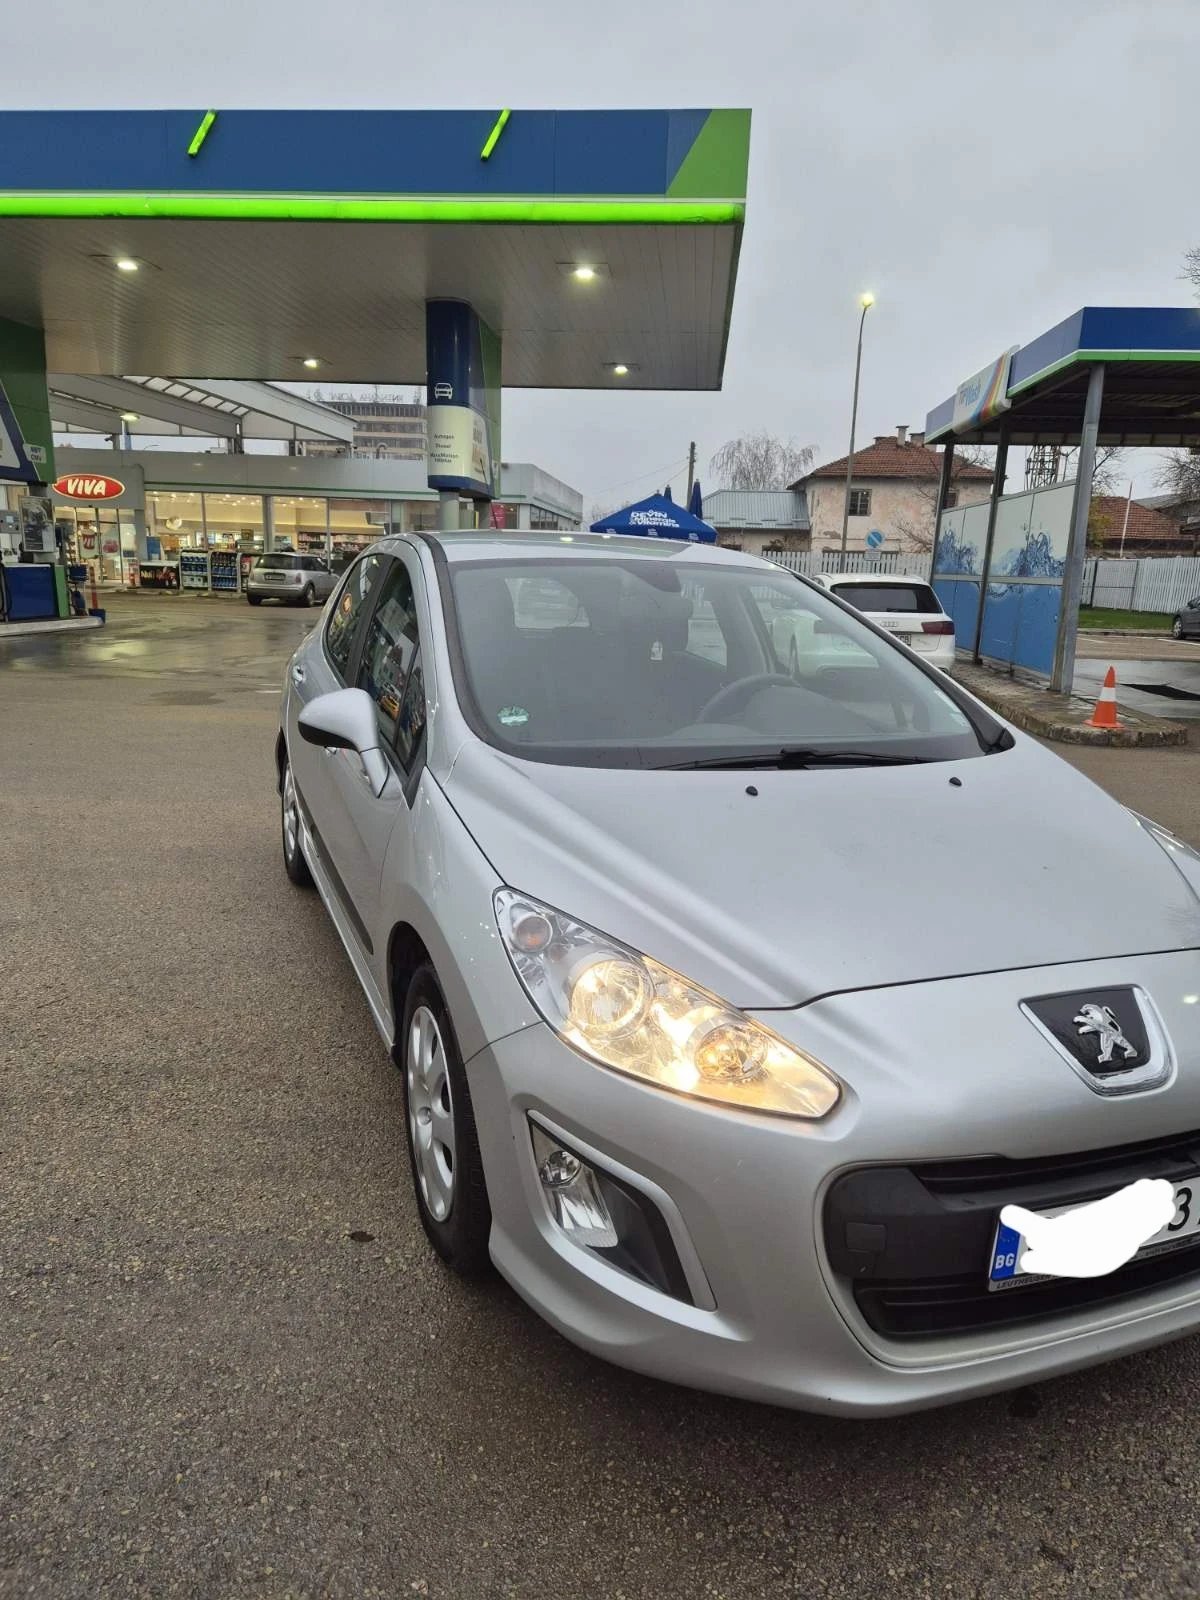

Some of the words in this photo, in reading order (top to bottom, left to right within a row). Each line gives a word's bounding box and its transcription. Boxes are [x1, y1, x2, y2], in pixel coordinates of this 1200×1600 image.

[67, 478, 107, 496] VIVA
[631, 510, 667, 518] DEVIN
[995, 1254, 1015, 1269] BG
